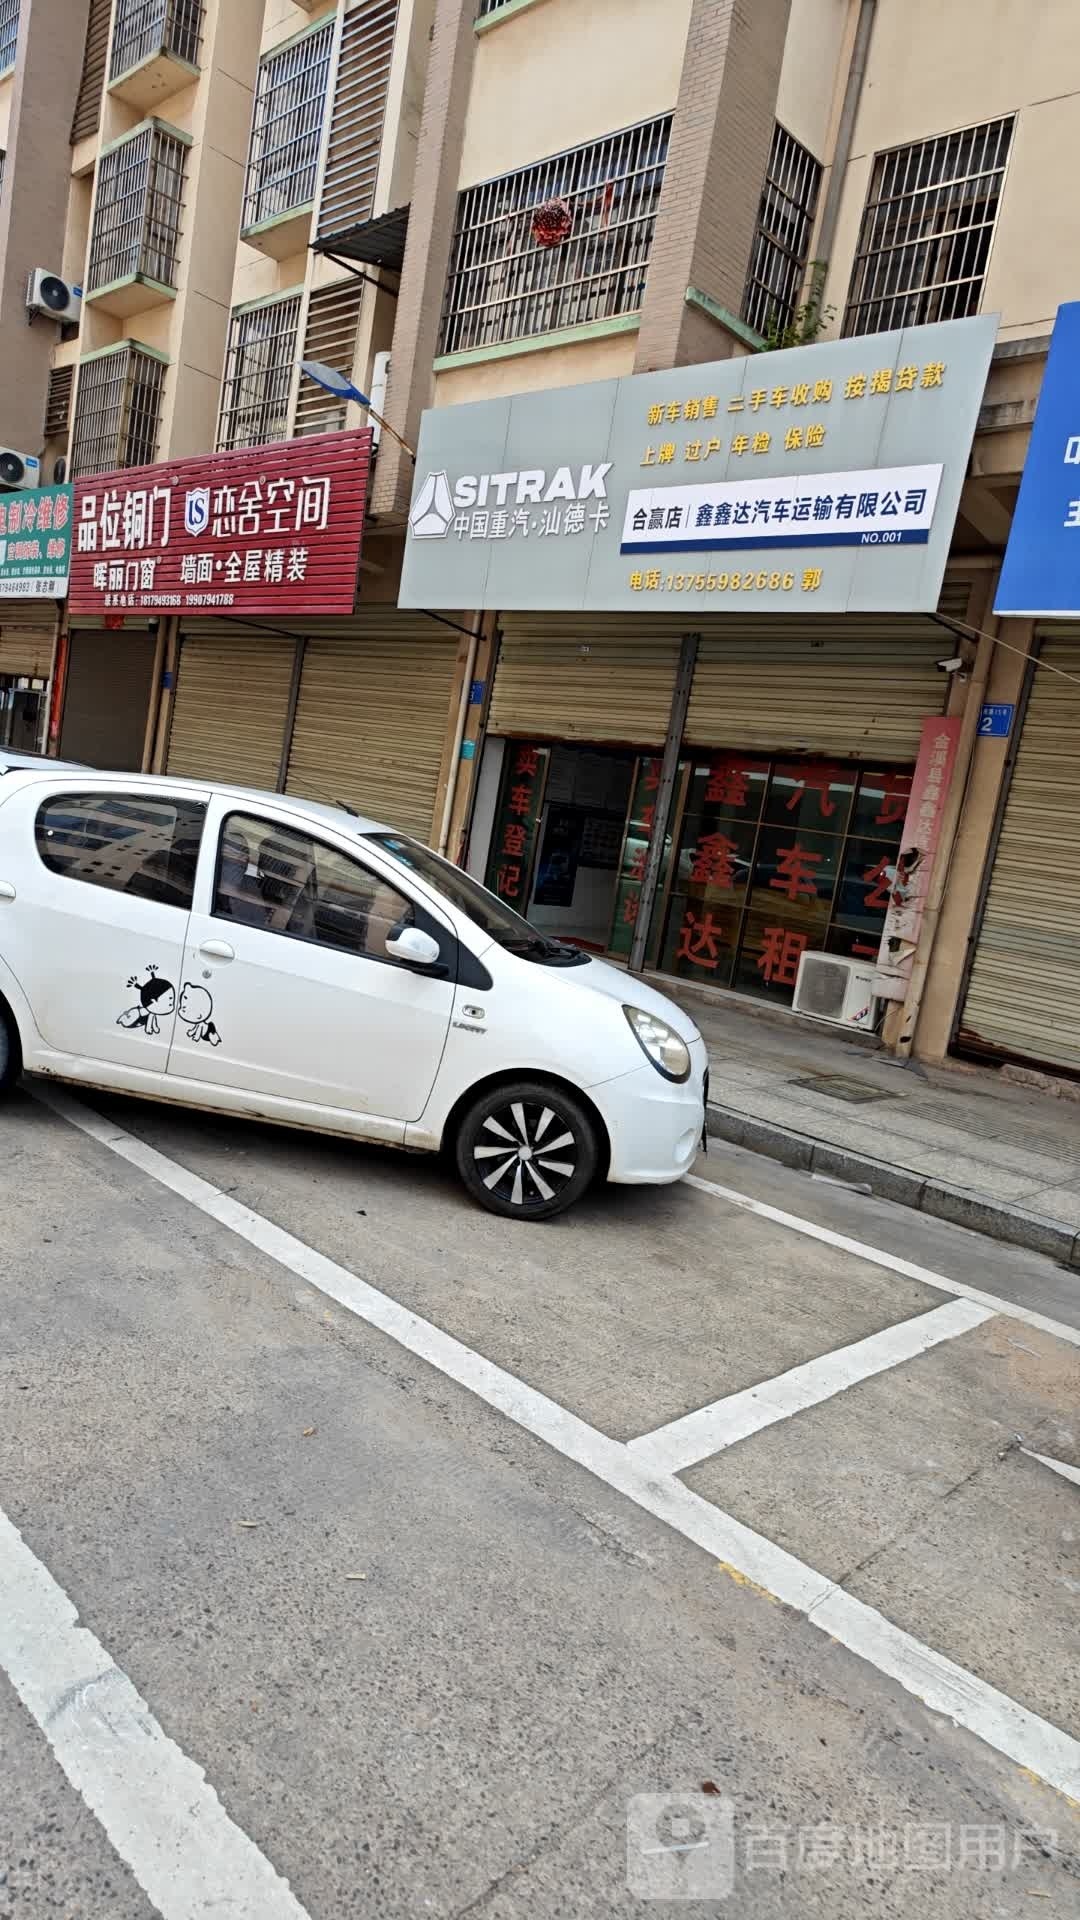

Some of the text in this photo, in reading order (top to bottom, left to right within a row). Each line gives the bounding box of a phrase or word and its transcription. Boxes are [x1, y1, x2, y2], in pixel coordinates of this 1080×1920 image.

[647, 361, 946, 425] 新车销售 二手车收购 按揭贷款
[639, 423, 827, 466] 上牌 过户 年检 保险
[212, 476, 331, 538] 恋舍空间
[453, 462, 614, 508] SITRAK
[78, 485, 171, 552] 品位铜门
[453, 500, 610, 541] 中国重汽·汕德卡
[632, 488, 928, 532] 合赢店 鑫鑫达汽车运输有限公司
[861, 531, 903, 544] NO.001
[93, 547, 309, 592] 晖丽门窗 墙面·全屋精装
[800, 567, 824, 592] 郭
[980, 717, 993, 732] 2
